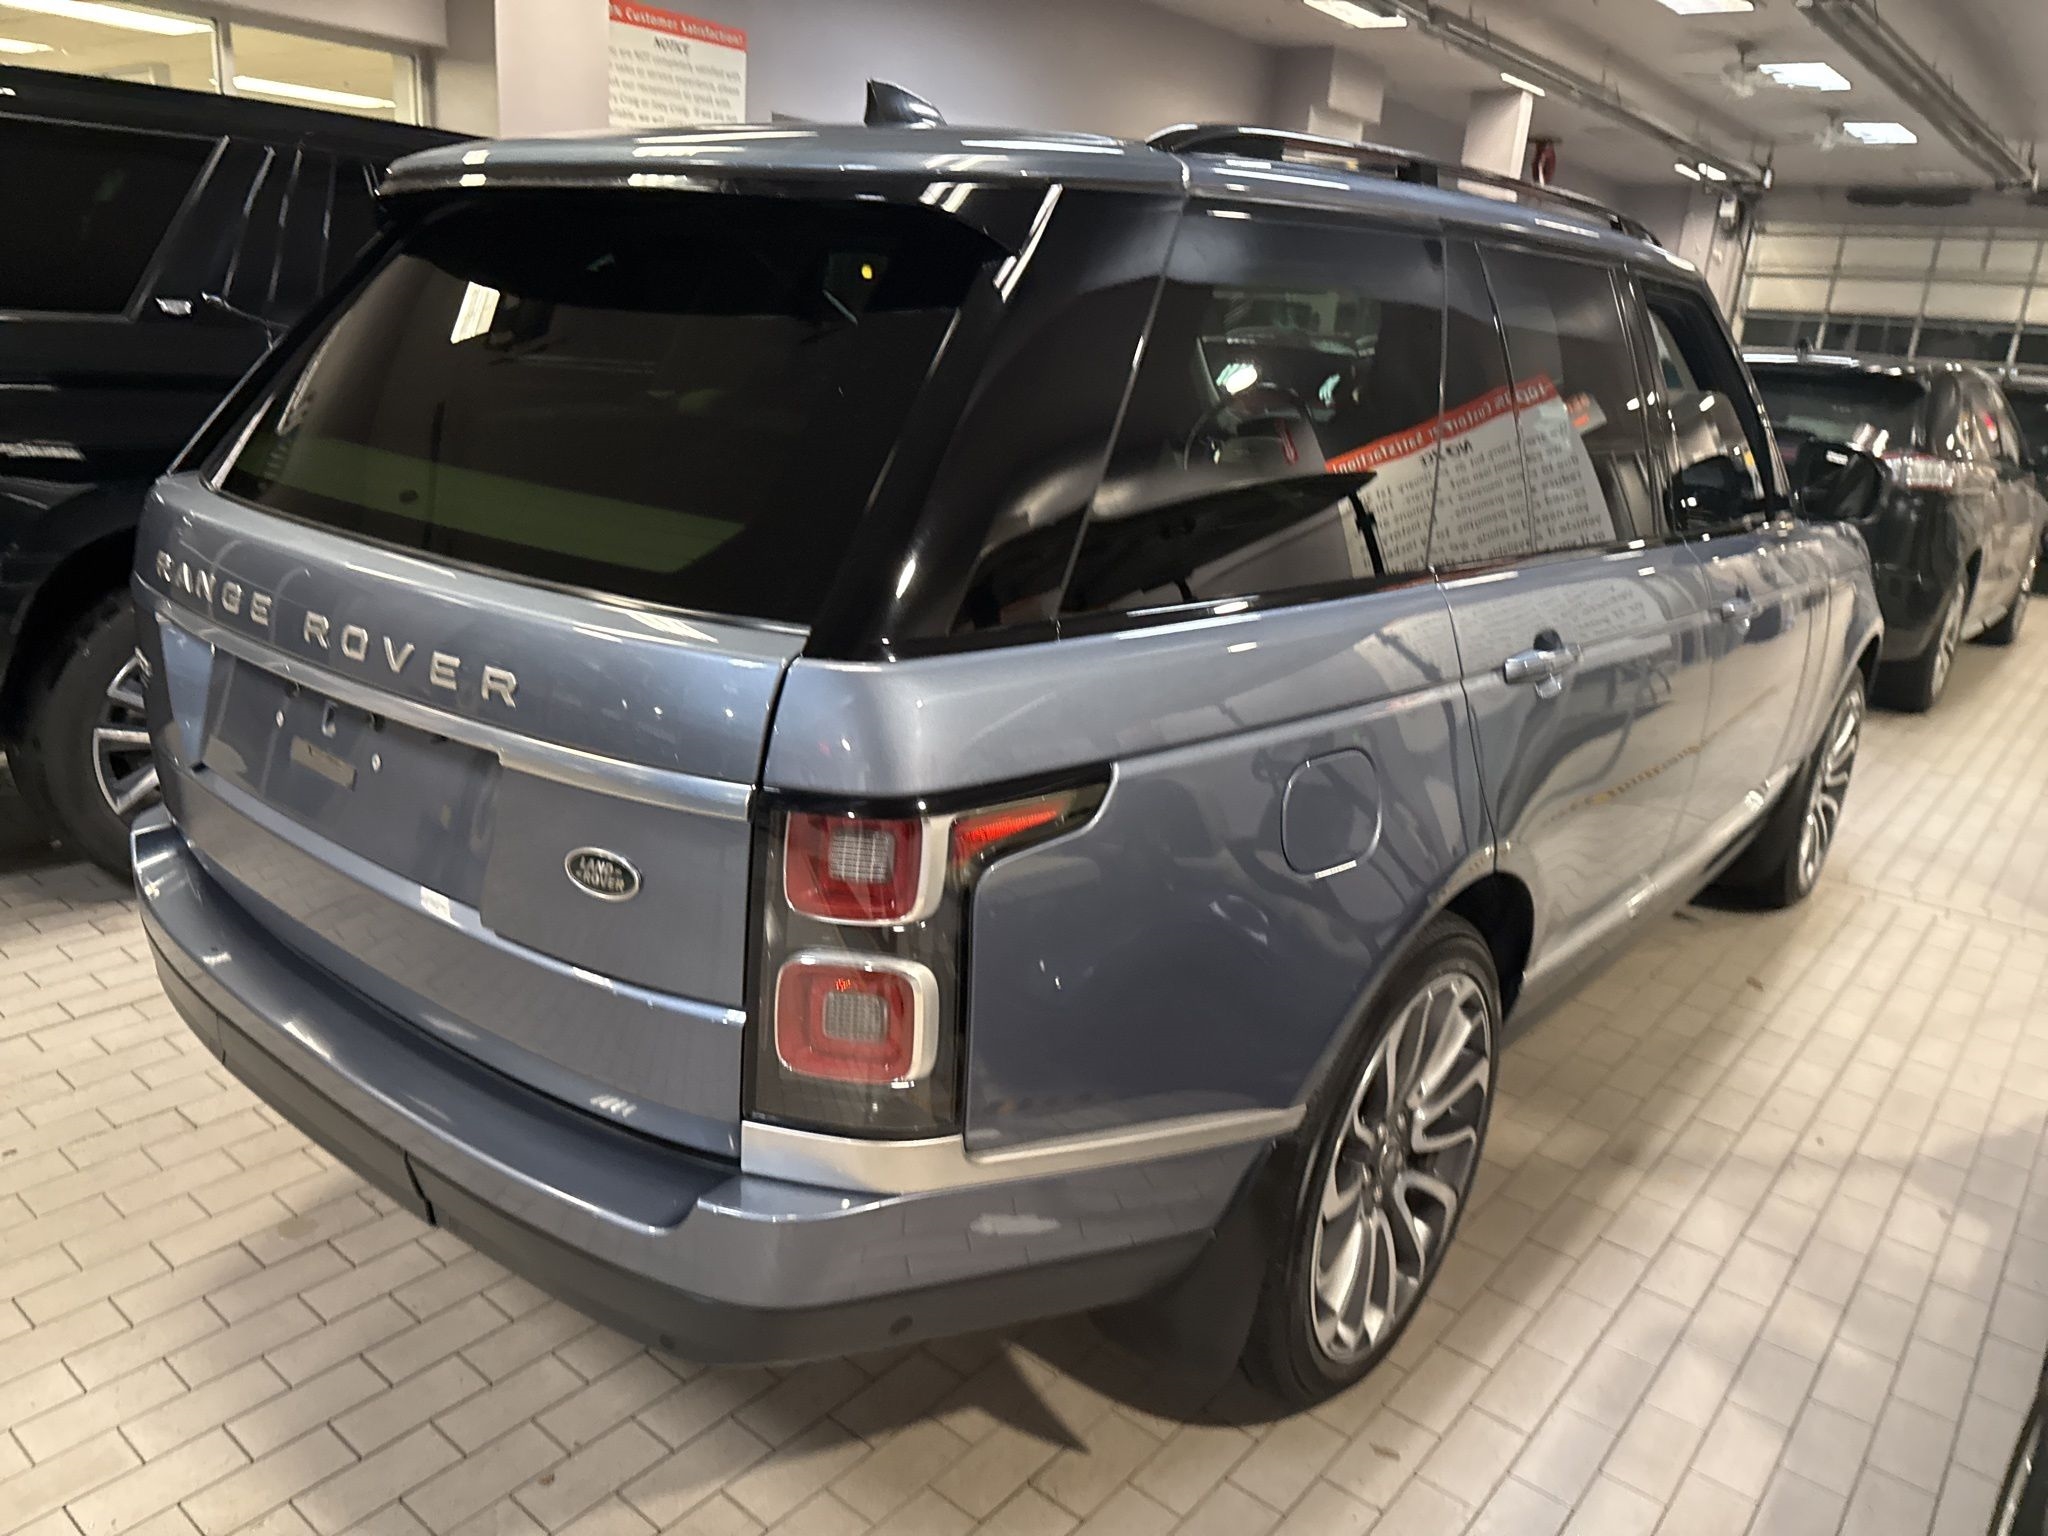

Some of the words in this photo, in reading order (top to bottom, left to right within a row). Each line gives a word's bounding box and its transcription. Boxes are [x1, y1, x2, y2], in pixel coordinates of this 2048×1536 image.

[624, 6, 677, 29] Customer
[155, 550, 273, 626] RANGE
[303, 611, 518, 709] ROVER
[580, 855, 614, 875] LAND
[584, 872, 625, 895] ROVER
